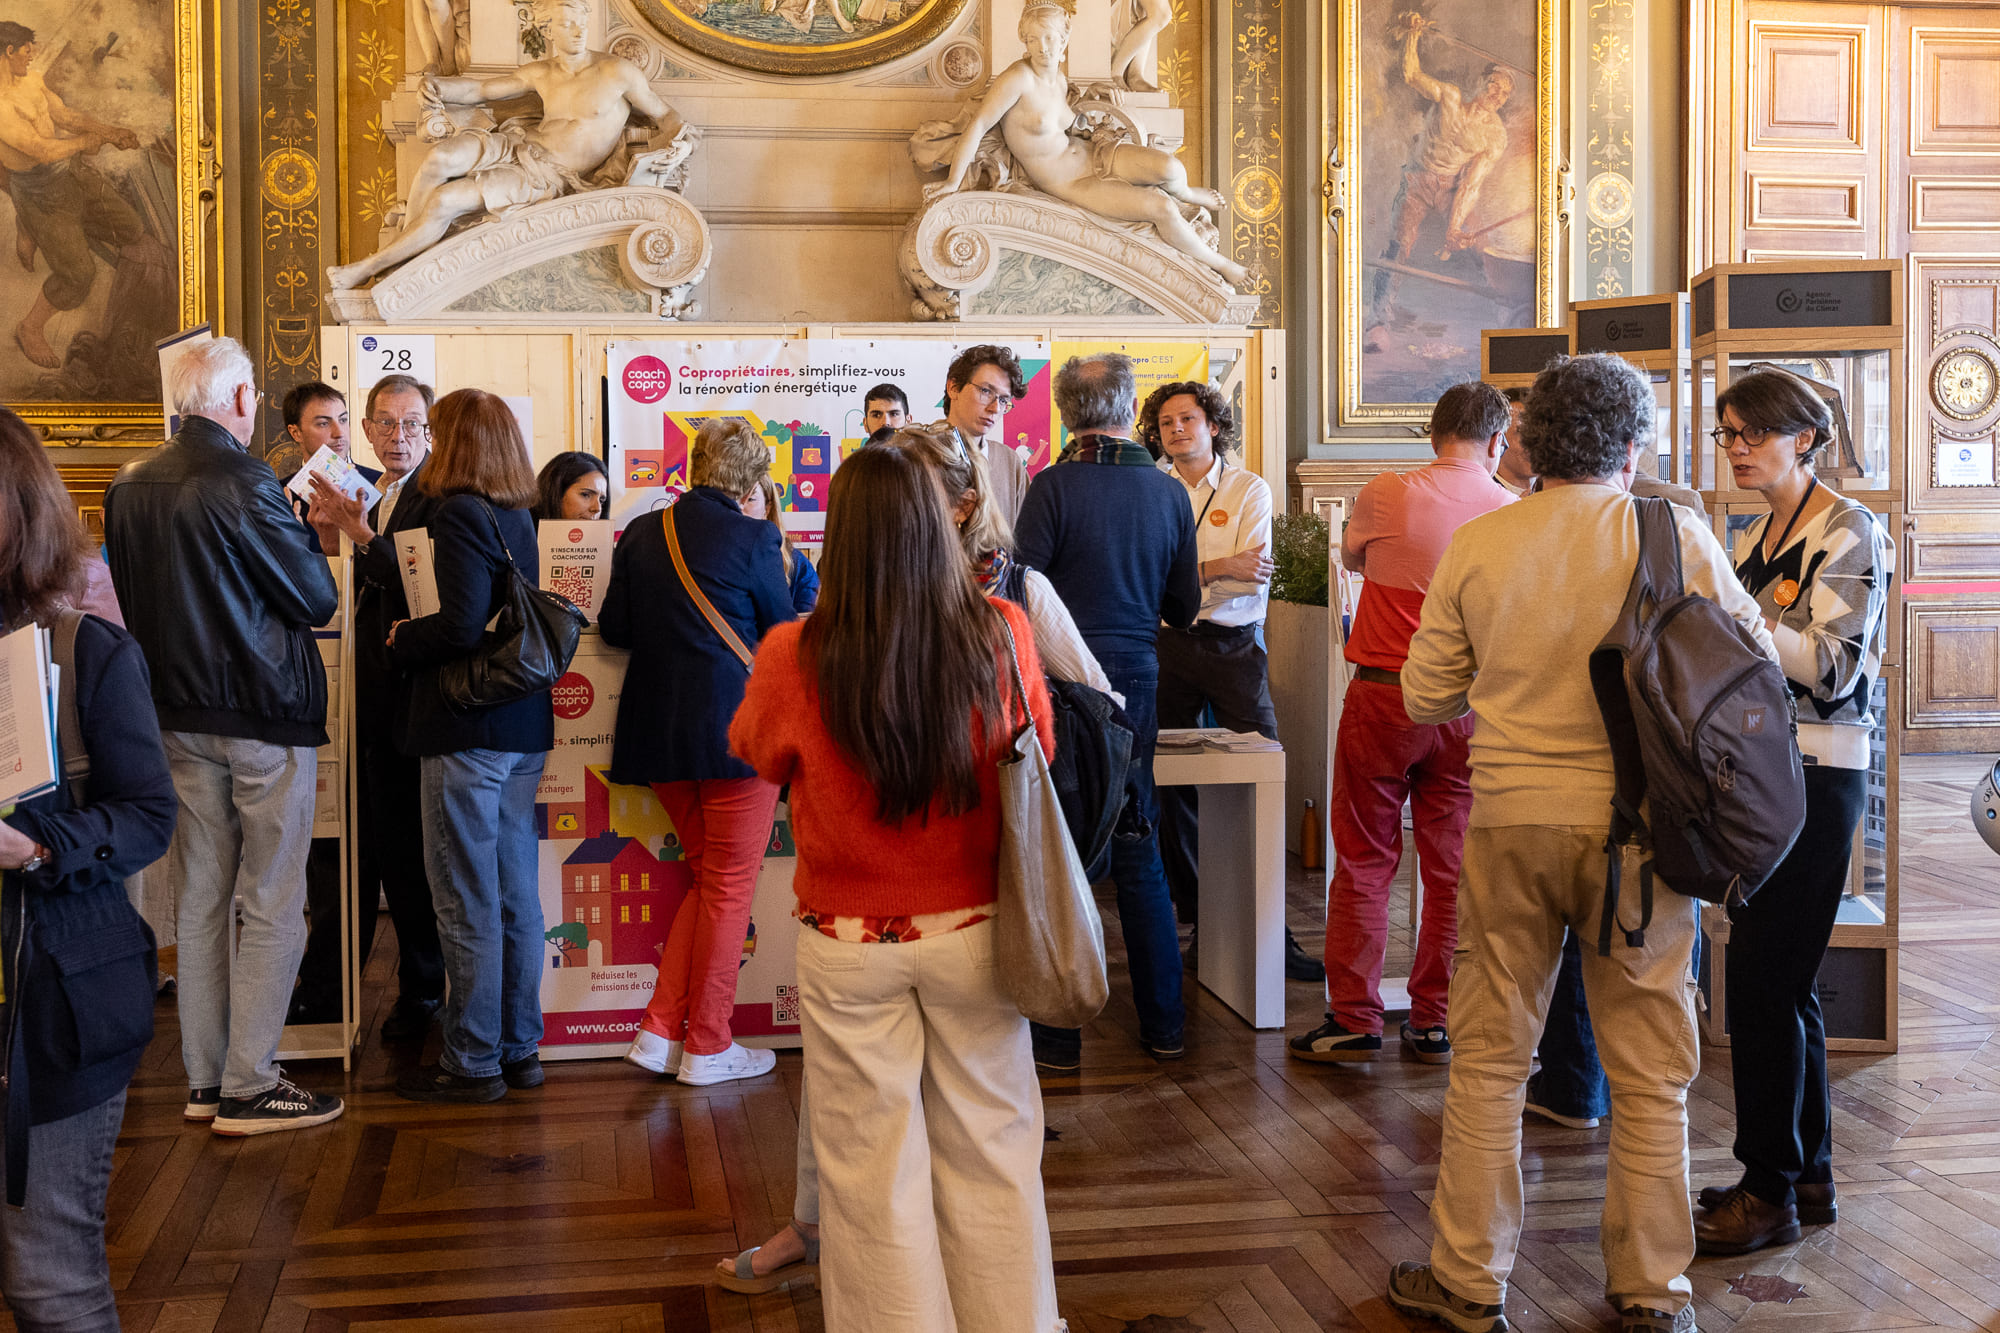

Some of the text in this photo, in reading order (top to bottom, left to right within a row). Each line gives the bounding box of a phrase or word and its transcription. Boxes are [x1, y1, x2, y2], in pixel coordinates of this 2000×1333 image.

[382, 350, 412, 371] 28
[628, 369, 666, 379] coach
[679, 362, 906, 381] Copropriétaires, simplifiez-vous
[628, 380, 666, 391] copro
[679, 378, 857, 397] la rénovation énergétique
[552, 685, 589, 695] coach
[552, 697, 589, 707] copro
[544, 785, 574, 795] charges
[591, 970, 638, 980] Réduisez les
[591, 982, 629, 991] émissions
[630, 982, 640, 990] de
[566, 1019, 642, 1034] www.coac
[265, 1100, 308, 1111] MUSTO
